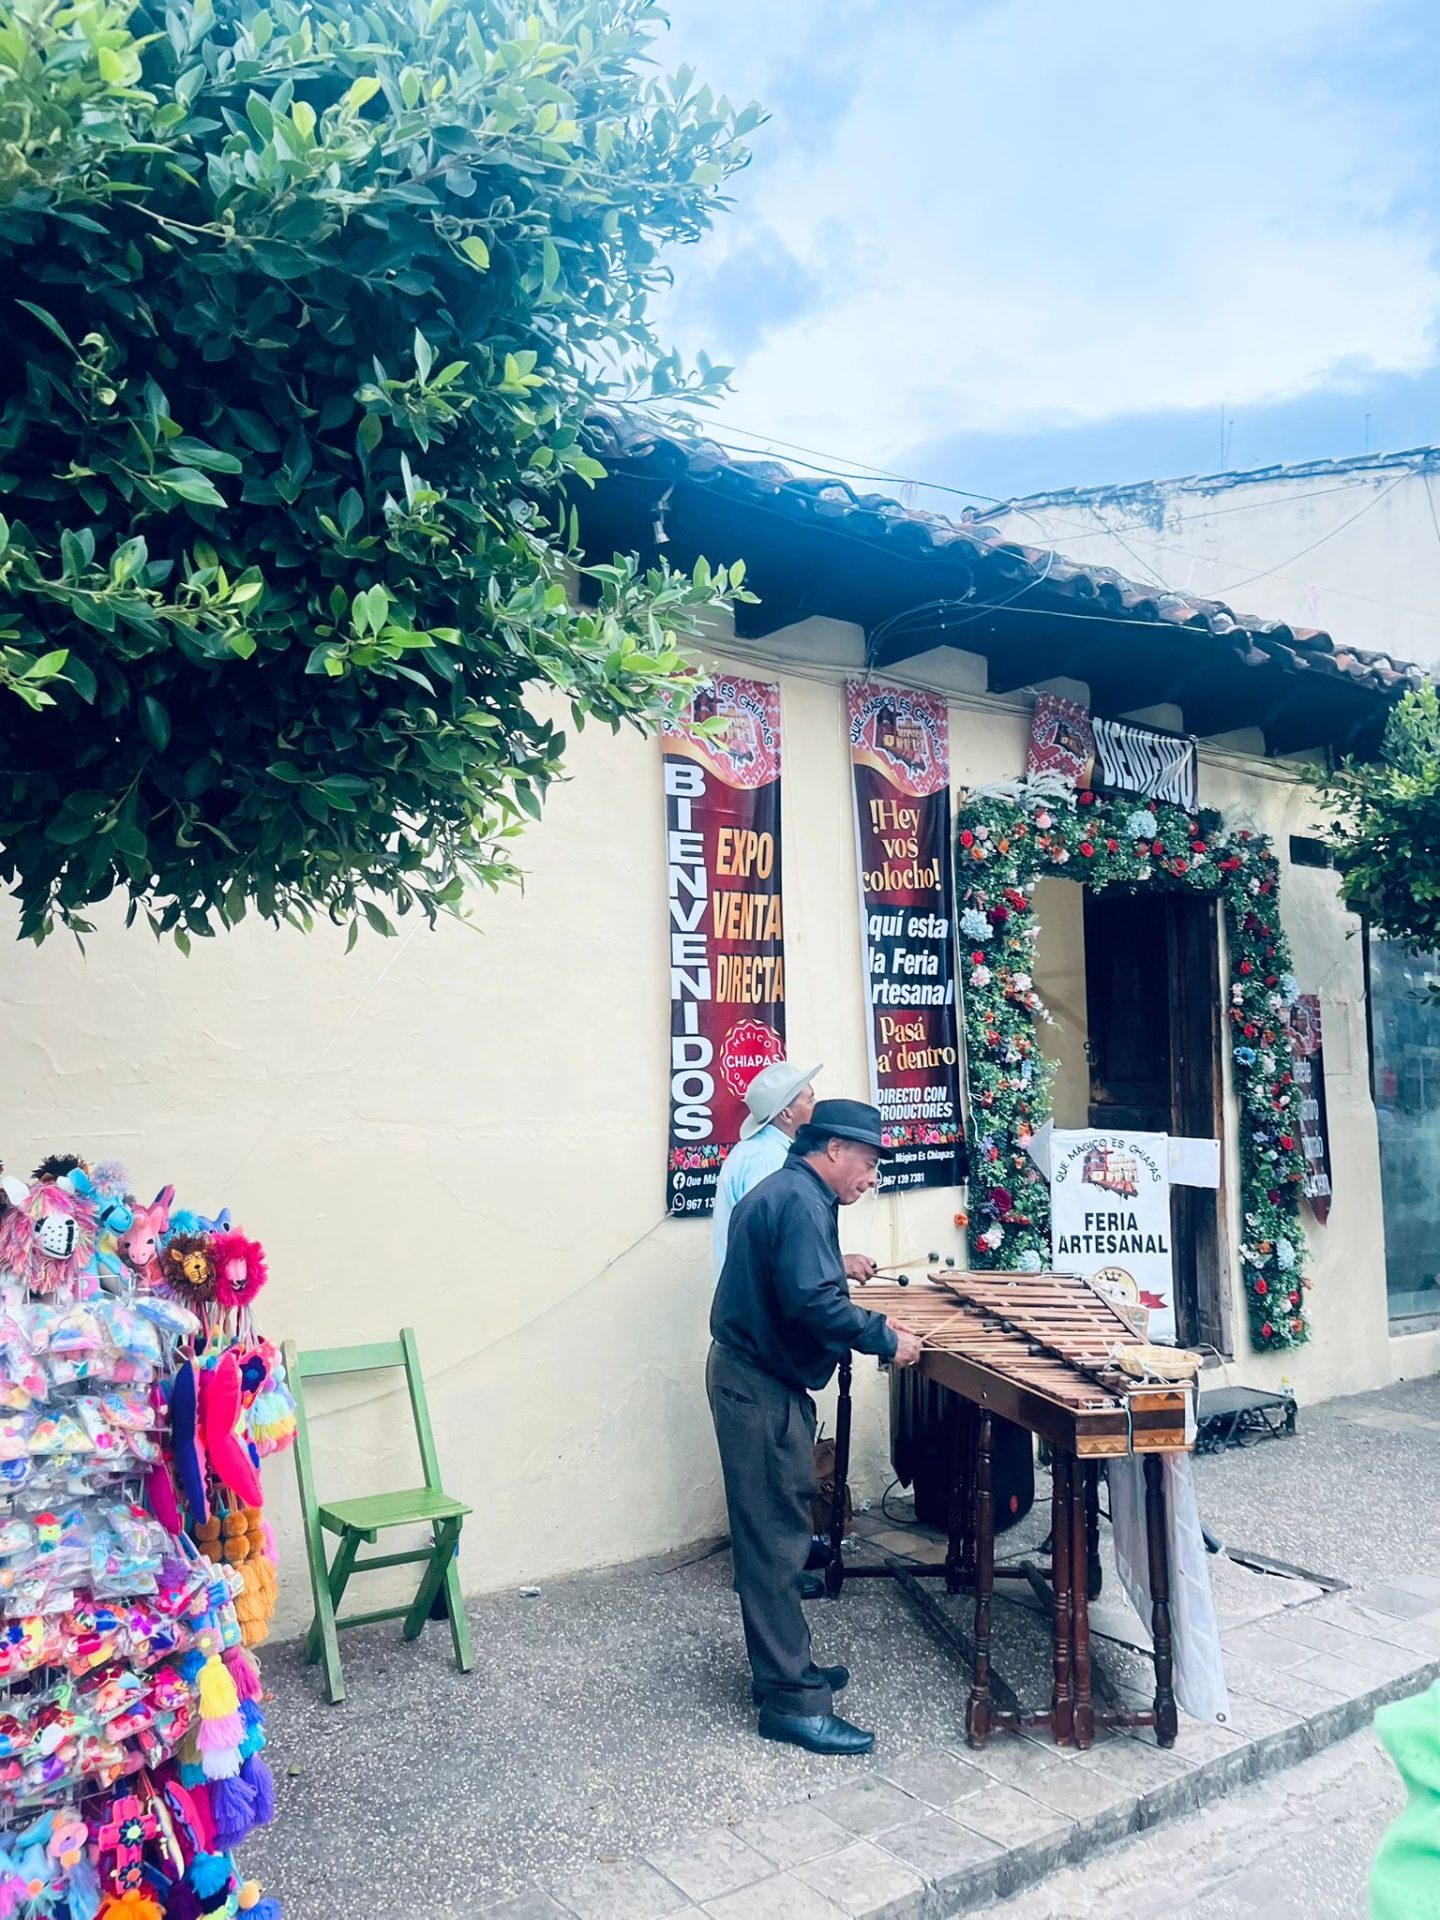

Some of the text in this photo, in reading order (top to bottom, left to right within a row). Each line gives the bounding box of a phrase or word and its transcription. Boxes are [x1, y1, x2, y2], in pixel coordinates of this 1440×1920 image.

[721, 684, 773, 746] ES CHIAPAS
[851, 717, 865, 743] QUE
[900, 698, 912, 712] ES
[869, 799, 921, 836] !Hey
[716, 827, 774, 880] EXPO
[882, 837, 919, 859] vos
[863, 858, 942, 892] colocho!
[712, 891, 782, 941] VENTA
[867, 909, 949, 941] quí esta
[664, 763, 714, 1141] BIENVENIDOS
[892, 948, 939, 975] Feria
[716, 955, 784, 1004] DIRECTA
[872, 979, 953, 1005] rtesanal
[879, 1016, 927, 1044] Pasá
[726, 1054, 780, 1068] CHIAPAS
[897, 1045, 957, 1071] dentro
[878, 1086, 947, 1105] DIRECTO CON
[880, 1102, 953, 1121] RODUCTORES
[1055, 1161, 1070, 1183] QUE
[1111, 1137, 1125, 1149] ES
[1129, 1144, 1161, 1182] CHIAPAS
[686, 1176, 702, 1188] Que
[686, 1199, 702, 1211] 967
[1084, 1212, 1138, 1231] FERIA
[1058, 1234, 1168, 1255] ARTESANAL
